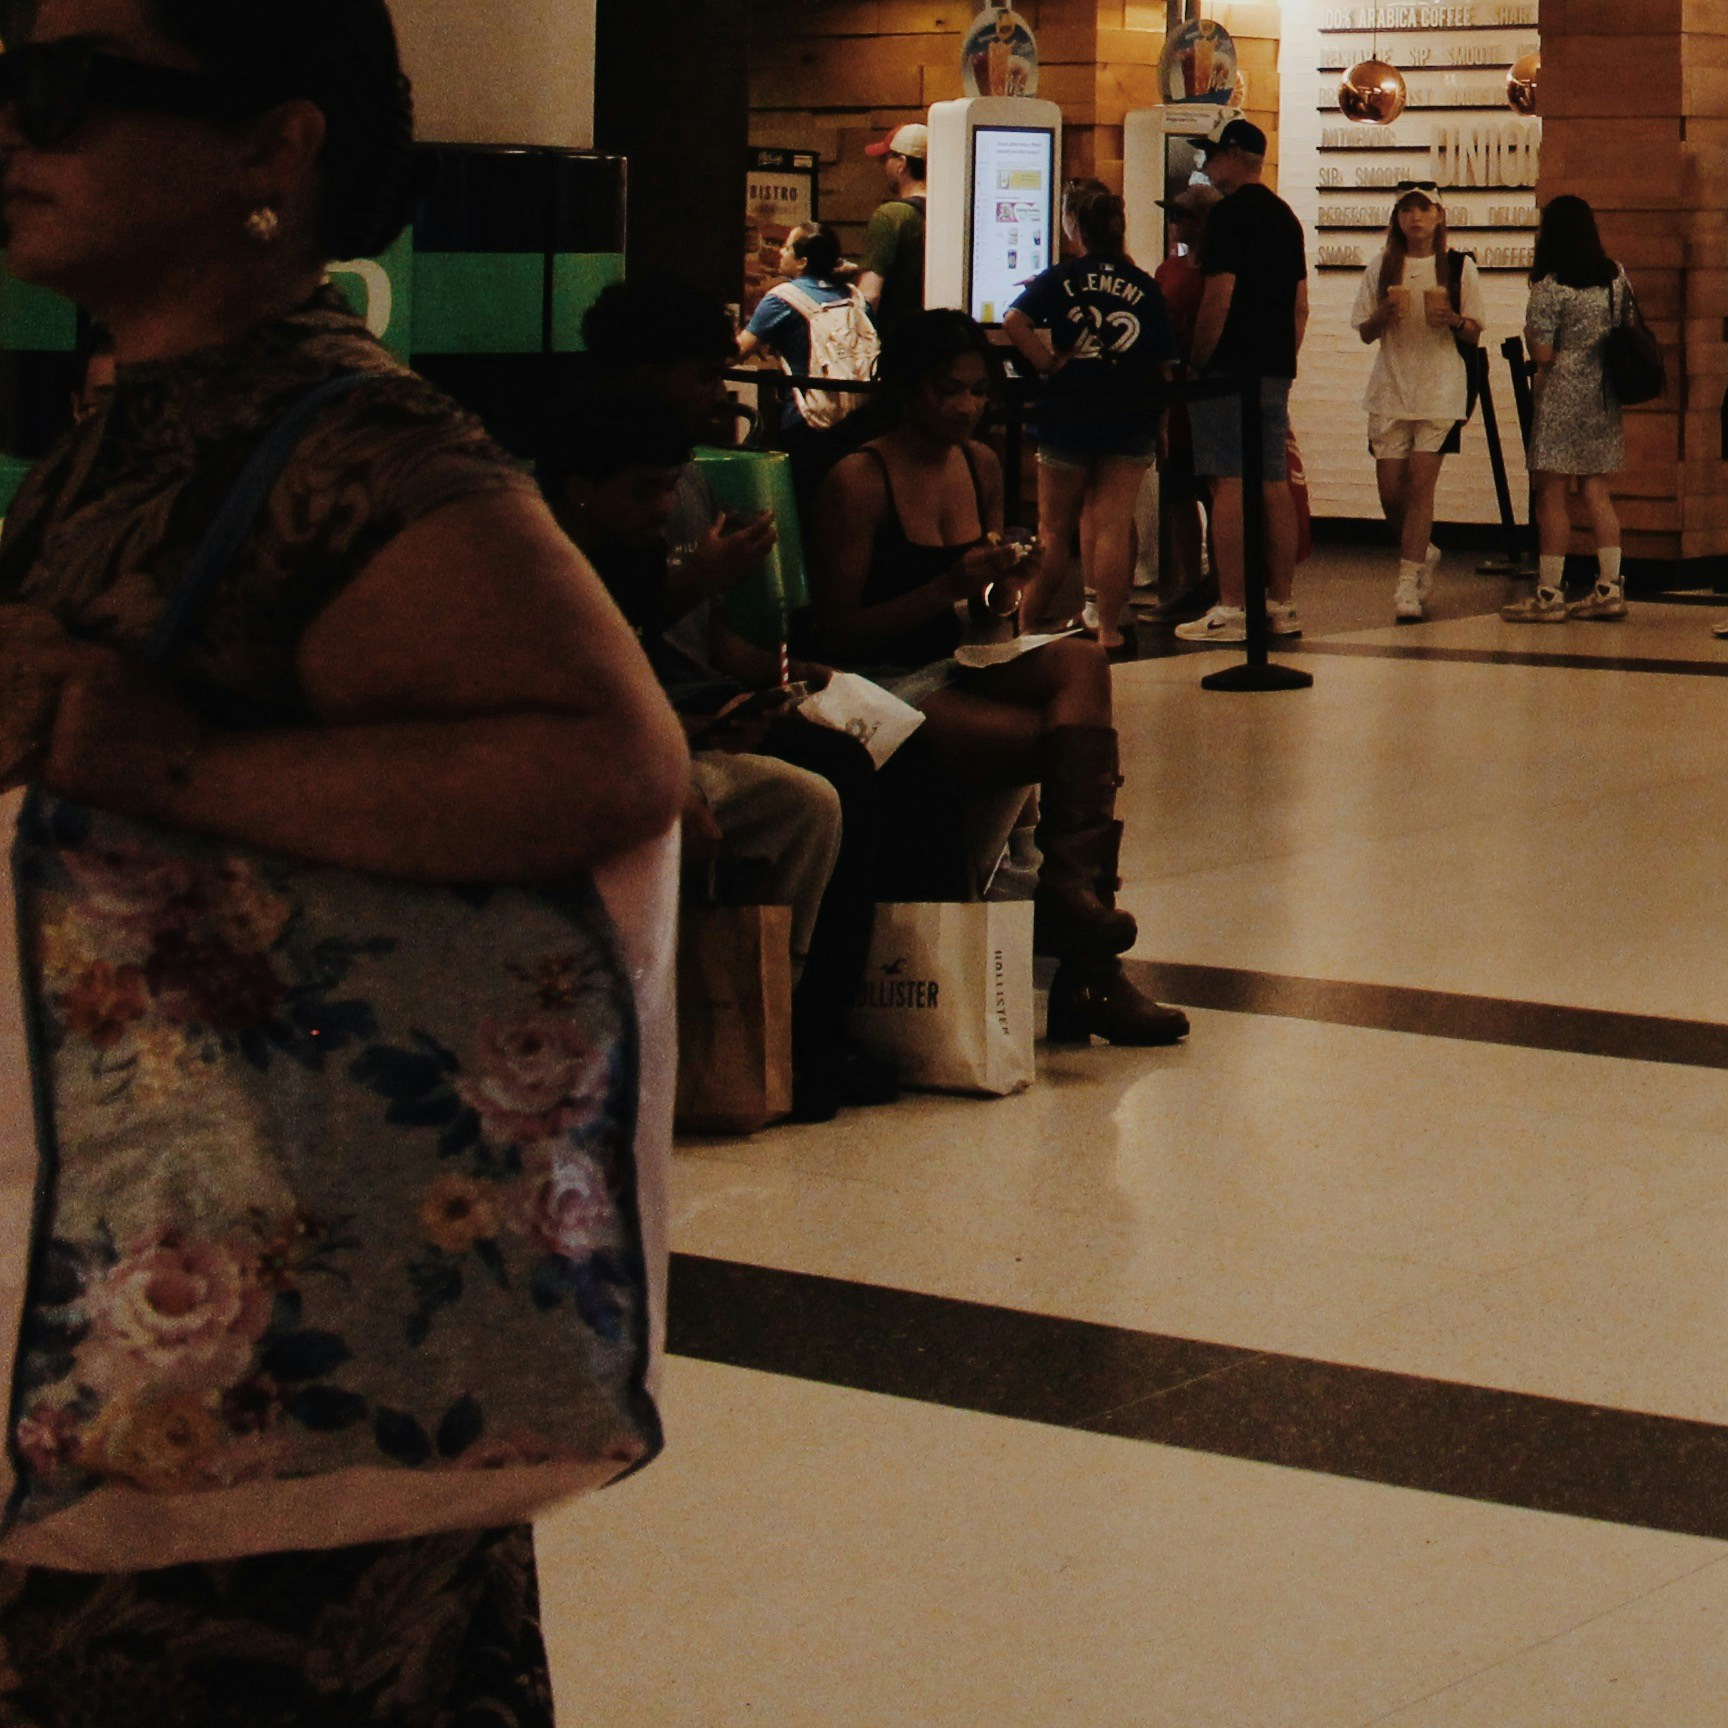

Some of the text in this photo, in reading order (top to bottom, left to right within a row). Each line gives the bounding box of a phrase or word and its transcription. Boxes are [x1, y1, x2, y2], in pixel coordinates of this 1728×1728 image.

[1359, 7, 1416, 28] ARABICA
[1421, 6, 1474, 26] COFFEE
[750, 185, 797, 201] BISTRO
